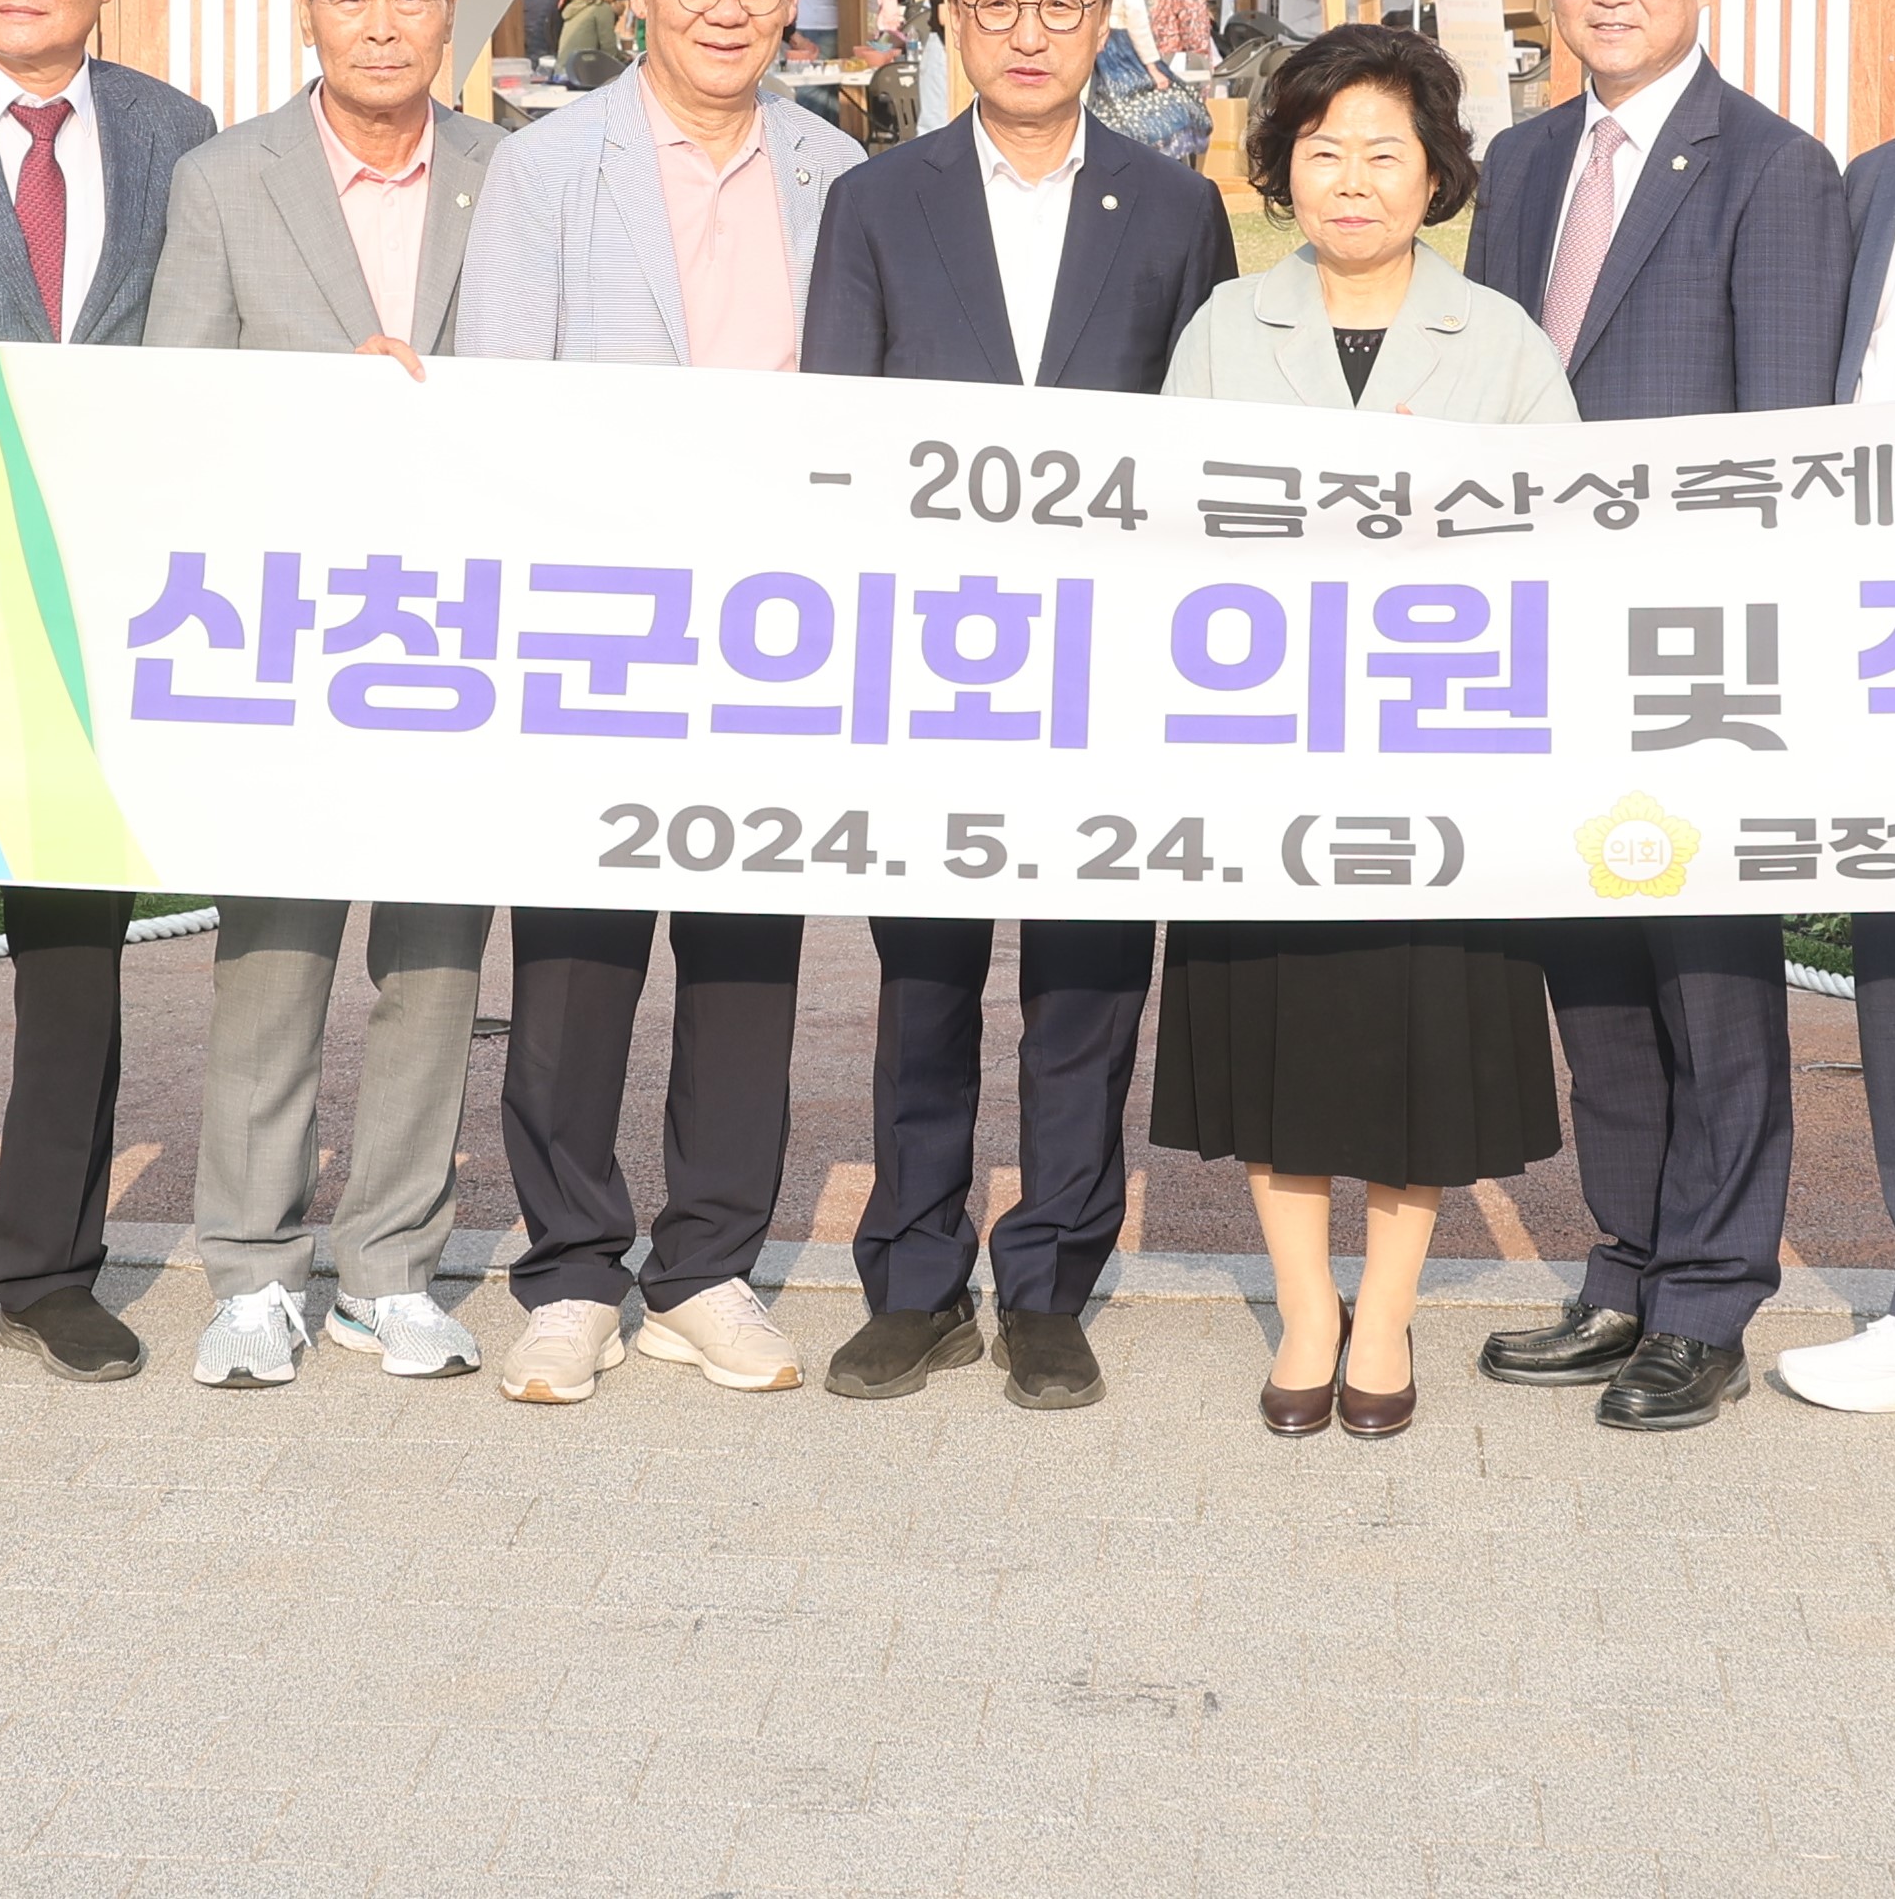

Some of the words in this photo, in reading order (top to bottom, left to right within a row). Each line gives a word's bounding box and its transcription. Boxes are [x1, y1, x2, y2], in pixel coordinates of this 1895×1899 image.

[909, 440, 1149, 531] 2024
[1197, 443, 1894, 540] 금정산성축제
[127, 551, 1090, 750] 산청군의회
[1165, 581, 1551, 754] 의원
[1628, 603, 1788, 752] 및
[598, 803, 906, 876] 2024.
[943, 813, 1038, 879] 5.
[1076, 814, 1243, 883] 24.
[1281, 813, 1465, 887] (금)
[1607, 838, 1663, 865] 의회
